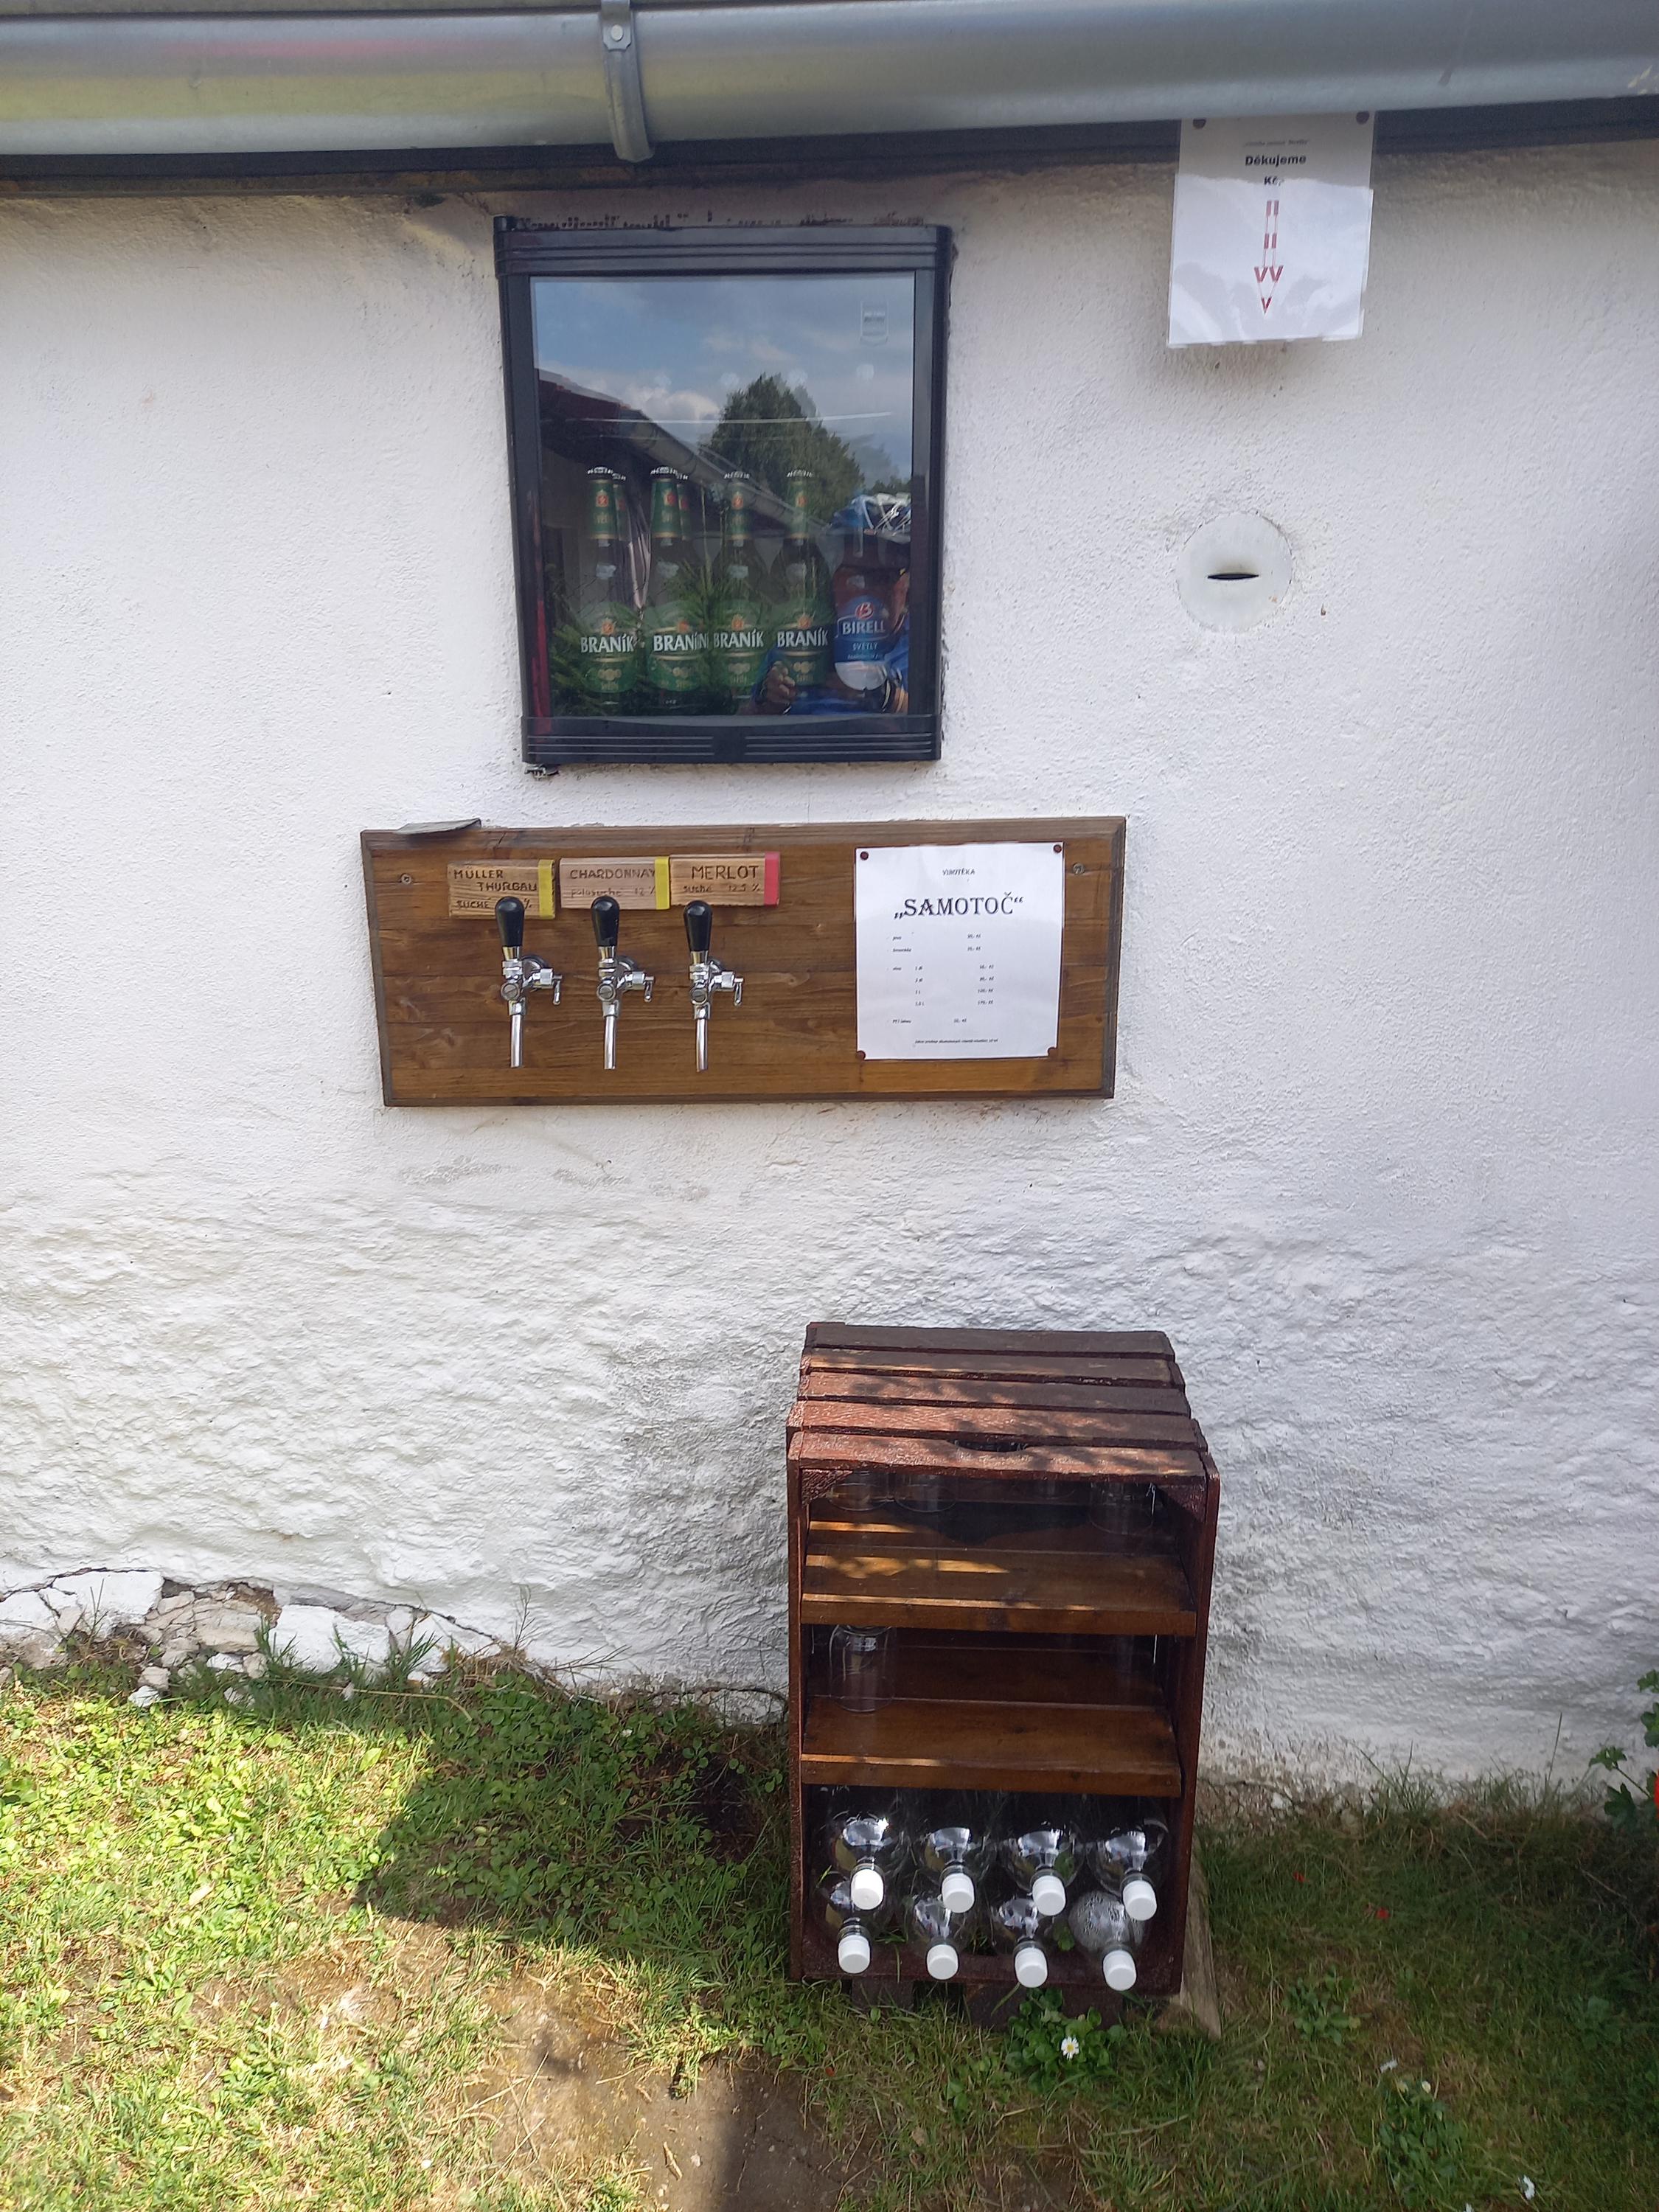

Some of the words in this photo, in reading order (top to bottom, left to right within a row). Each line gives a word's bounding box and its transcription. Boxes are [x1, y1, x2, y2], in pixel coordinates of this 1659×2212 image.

[1245, 154, 1307, 167] Děkujeme
[842, 620, 885, 635] BIRELL
[580, 633, 635, 653] BRANÍK
[714, 629, 764, 647] BRANÍK
[777, 627, 828, 647] BRANÍK
[453, 866, 504, 879] MÜLLER
[570, 869, 655, 879] CHARDONNAY
[692, 865, 759, 880] MERLOT
[476, 882, 537, 891] THURGAU
